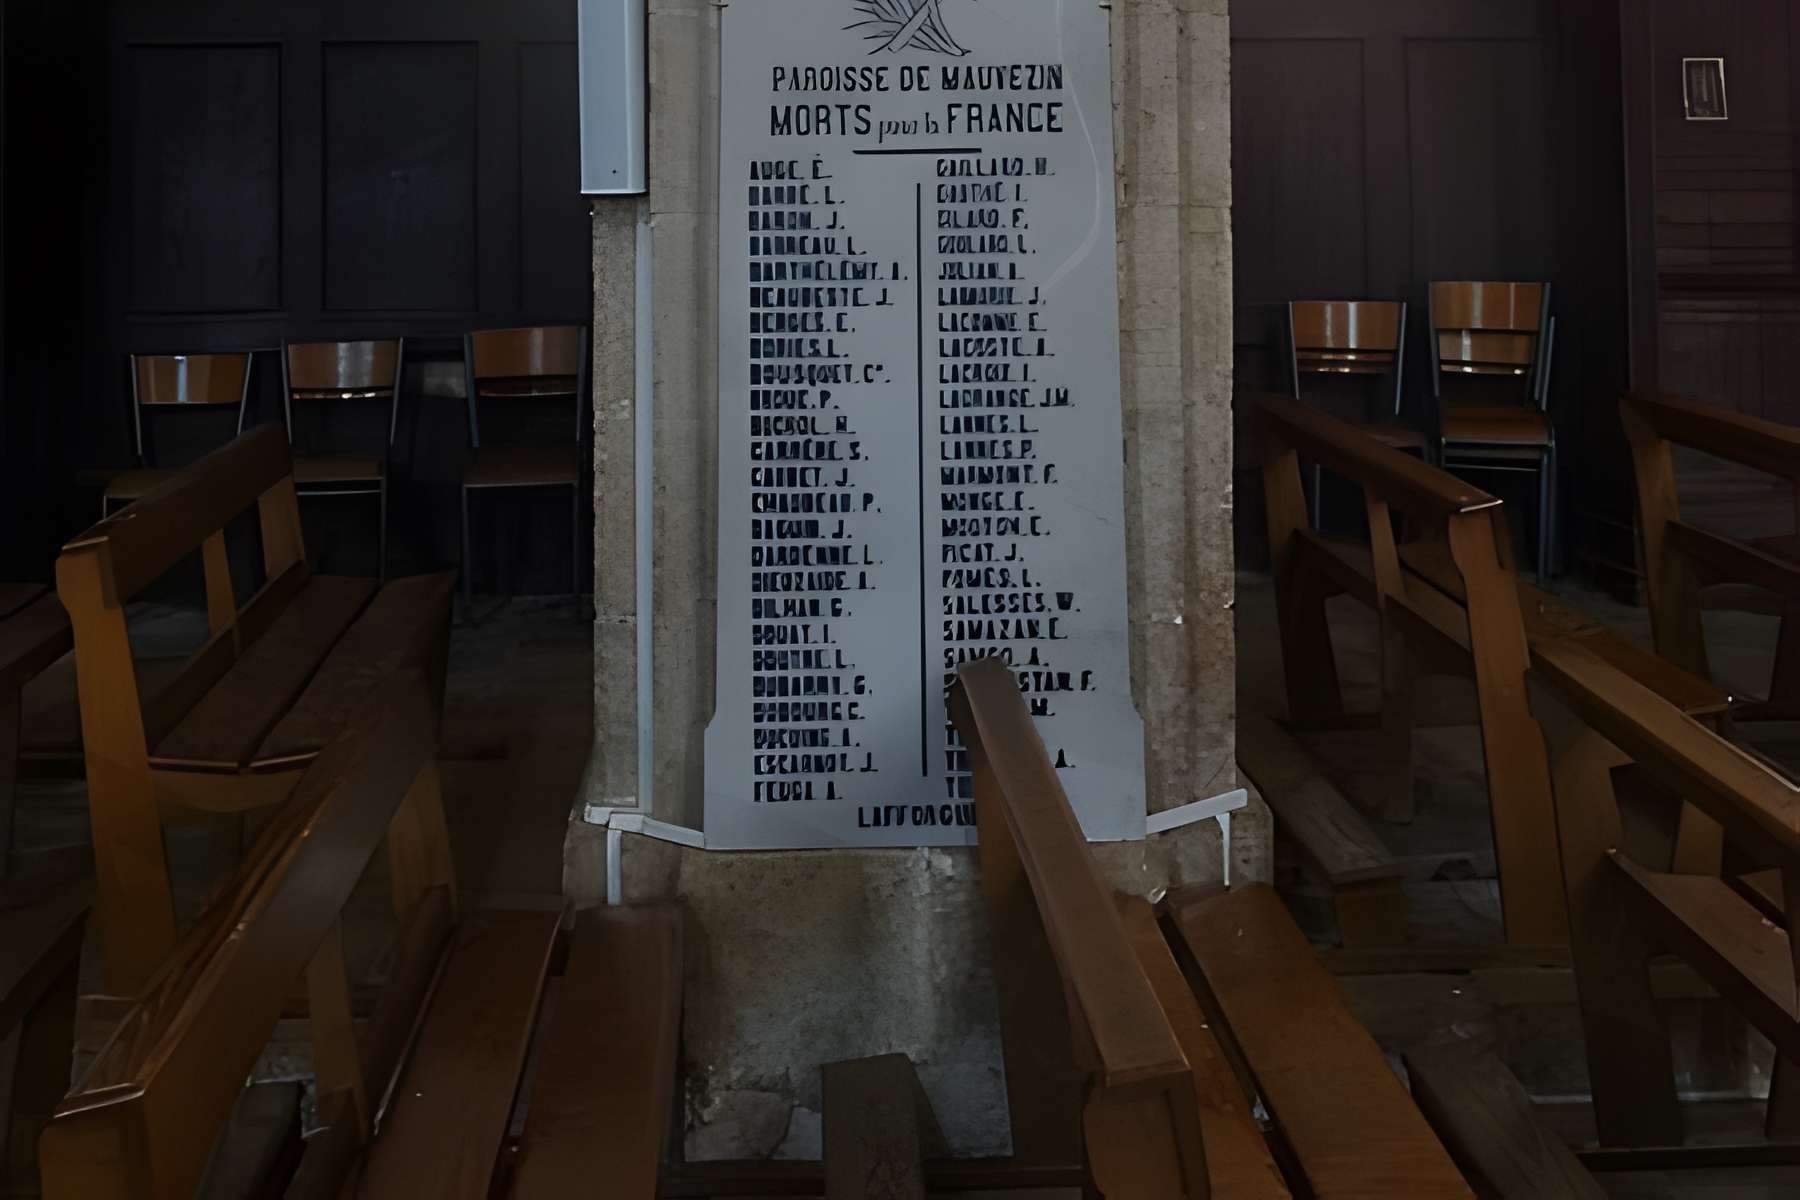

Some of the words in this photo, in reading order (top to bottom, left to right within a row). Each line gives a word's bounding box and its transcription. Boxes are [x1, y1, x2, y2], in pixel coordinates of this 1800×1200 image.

[773, 66, 889, 92] PAROISSE
[900, 66, 930, 91] DE
[942, 64, 1063, 91] MAUVEZIN
[771, 104, 871, 136] MORTS
[947, 102, 1063, 134] FRANCE
